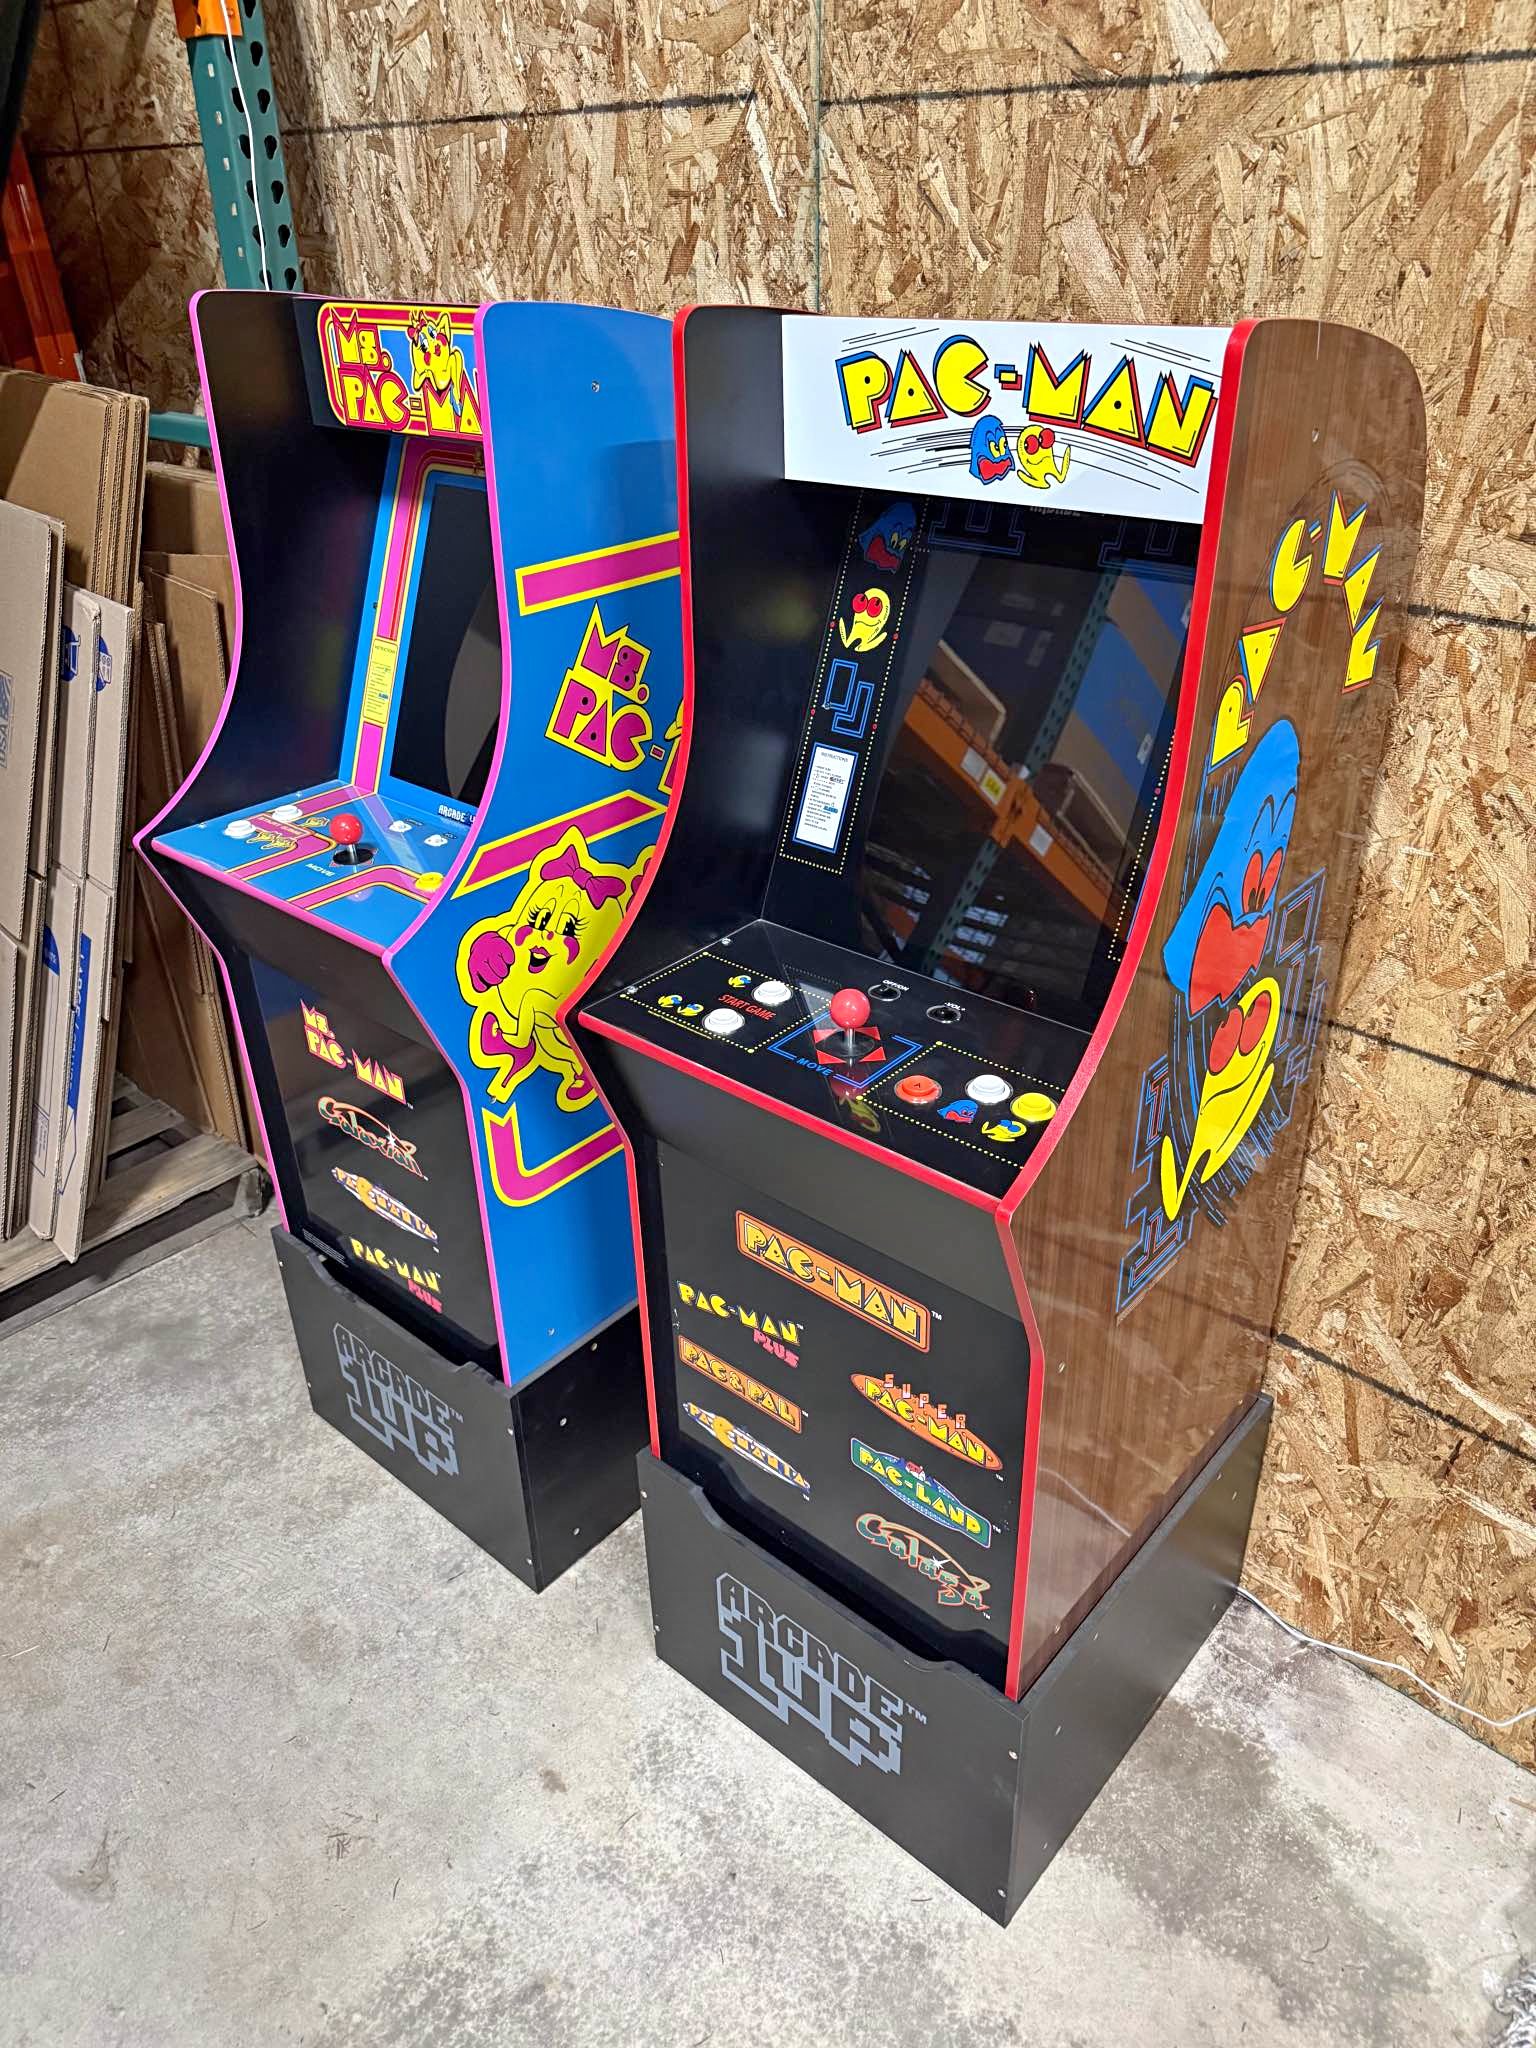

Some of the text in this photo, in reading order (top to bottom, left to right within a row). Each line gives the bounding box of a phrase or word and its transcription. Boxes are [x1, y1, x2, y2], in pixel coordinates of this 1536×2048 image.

[338, 365, 485, 438] PAC-MA
[835, 334, 1219, 468] PAC-MAN
[545, 667, 683, 796] PAC-
[438, 804, 466, 823] ARCADE
[306, 863, 337, 877] MOVE
[718, 994, 777, 1020] START GAME
[303, 1024, 407, 1105] PAC-MAN
[796, 1057, 834, 1076] MOVE
[350, 1236, 441, 1293] PAC-MAN
[743, 1219, 921, 1343] PAC-MAN
[677, 1281, 800, 1347] PAC-MAN
[333, 1323, 450, 1426] ARCADE
[883, 1373, 967, 1429] SUPER
[865, 1378, 987, 1465] PAC-MAN
[859, 1446, 982, 1535] PAC-LAND
[716, 1572, 904, 1722] ARCADE
